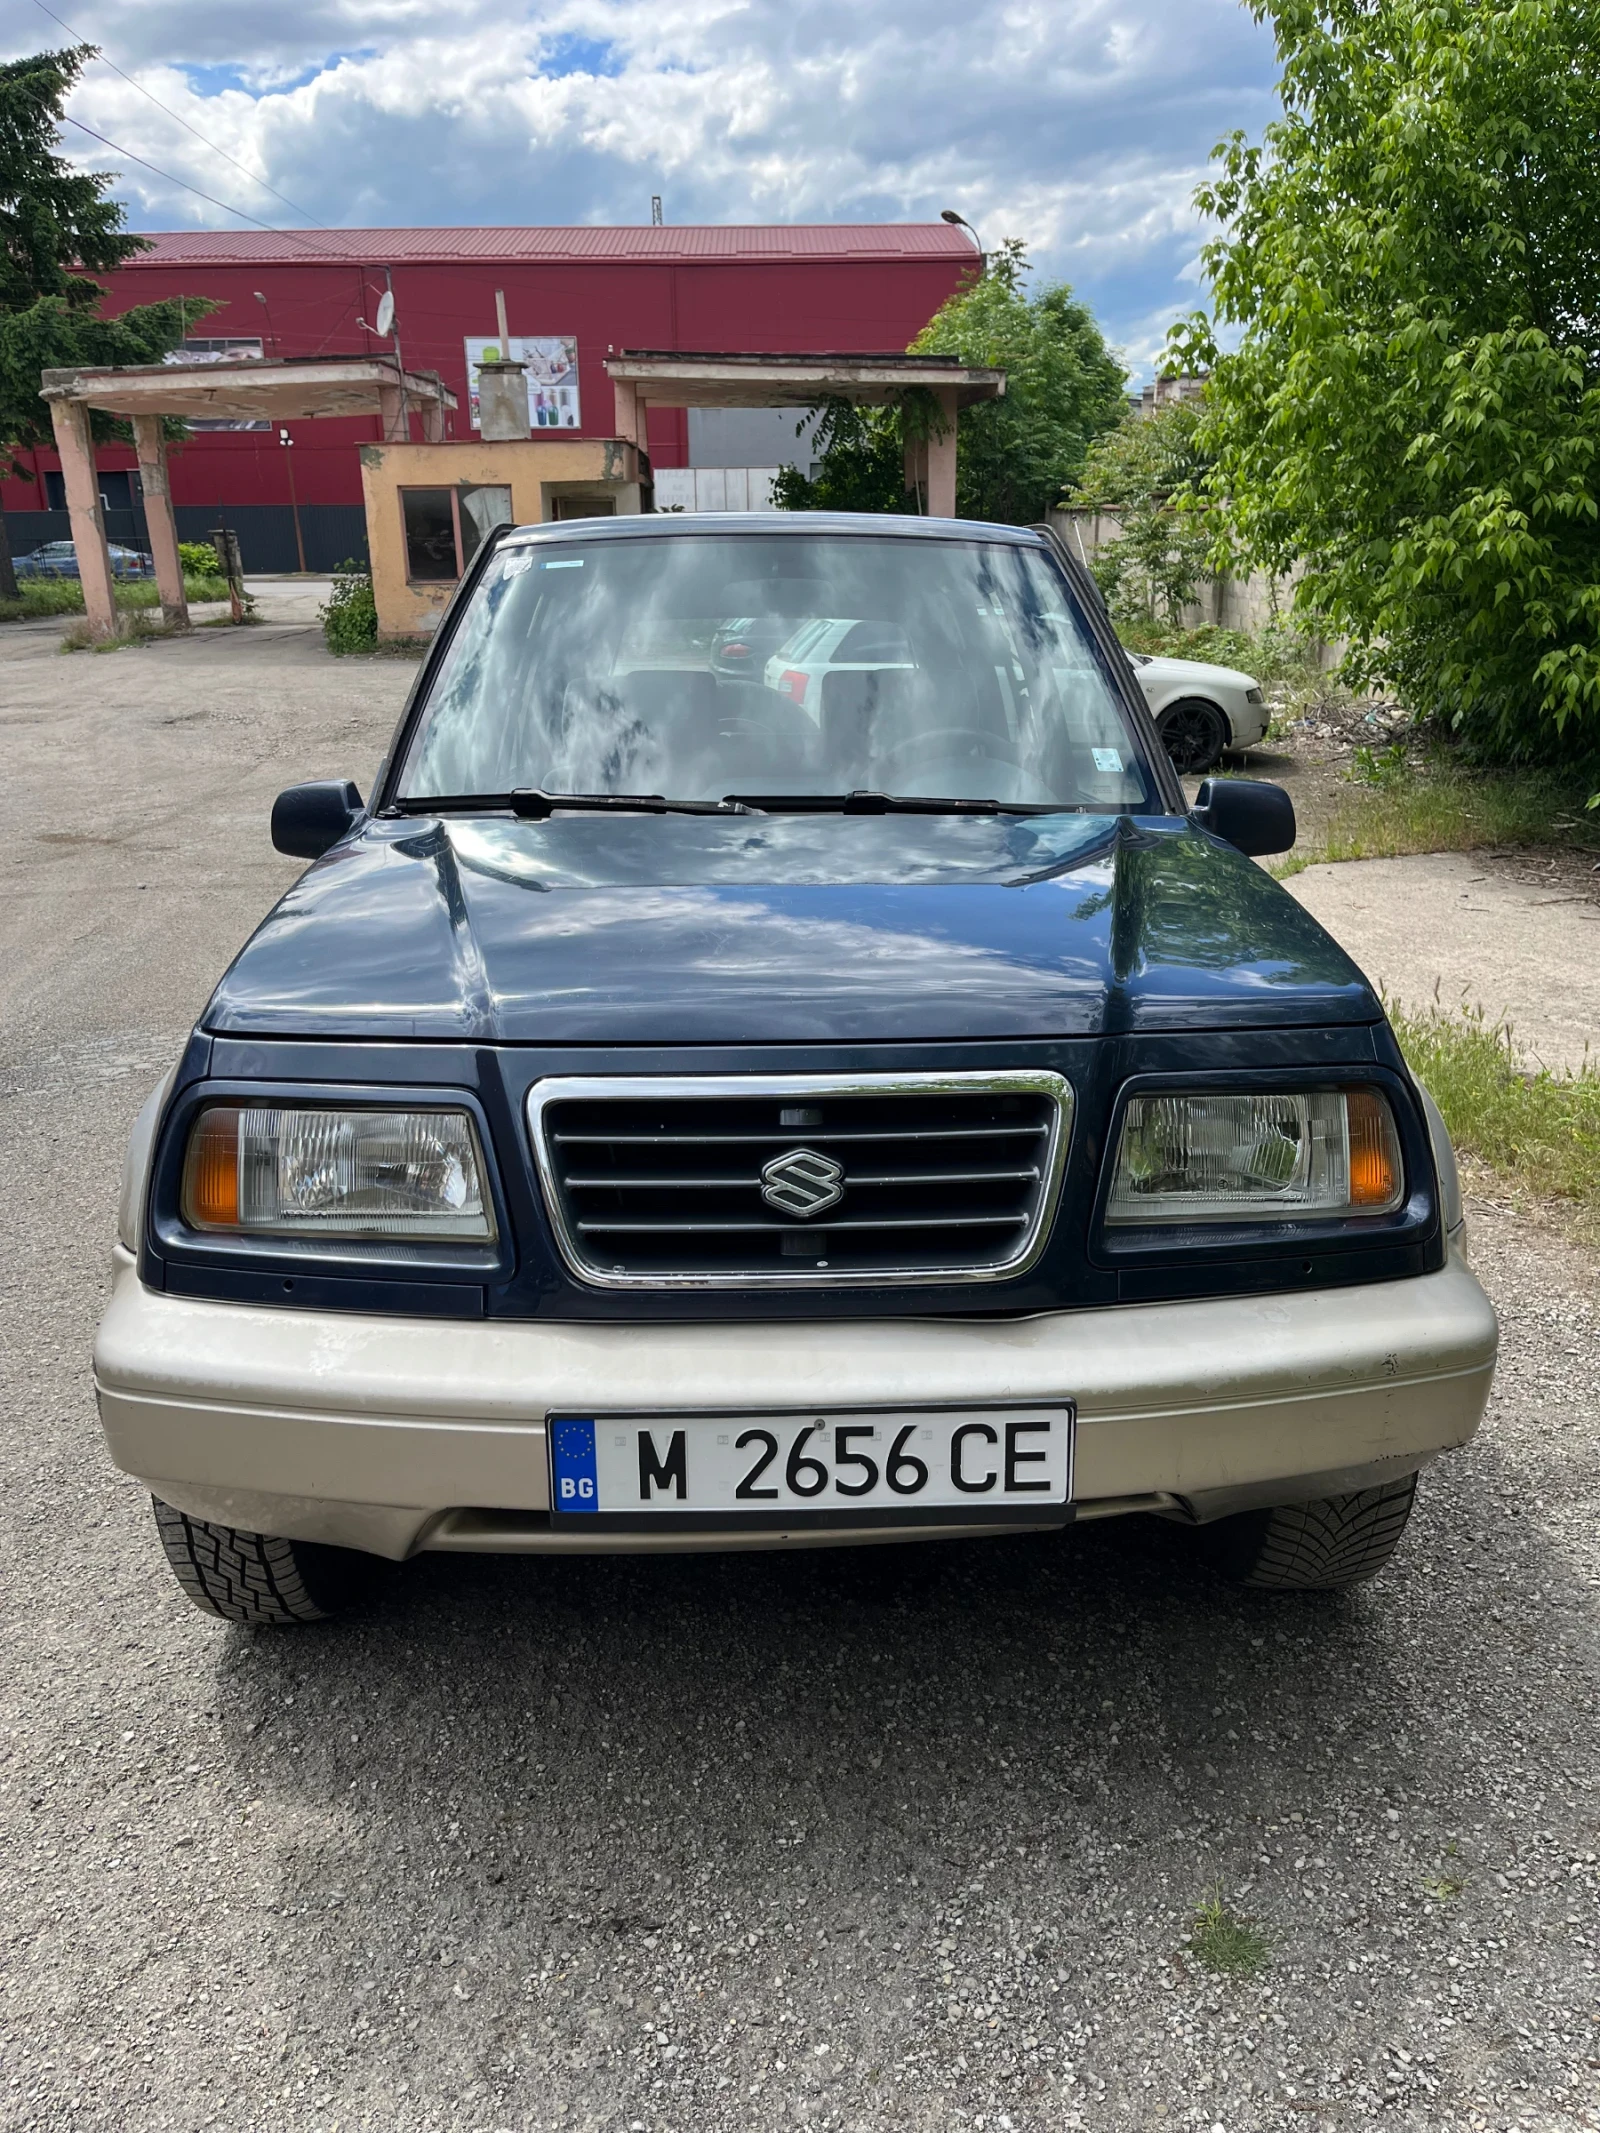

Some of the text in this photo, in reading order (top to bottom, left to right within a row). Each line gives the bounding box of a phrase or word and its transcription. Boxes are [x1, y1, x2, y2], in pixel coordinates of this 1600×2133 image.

[637, 1421, 1051, 1500] M 2656 CE
[561, 1477, 594, 1498] BG
